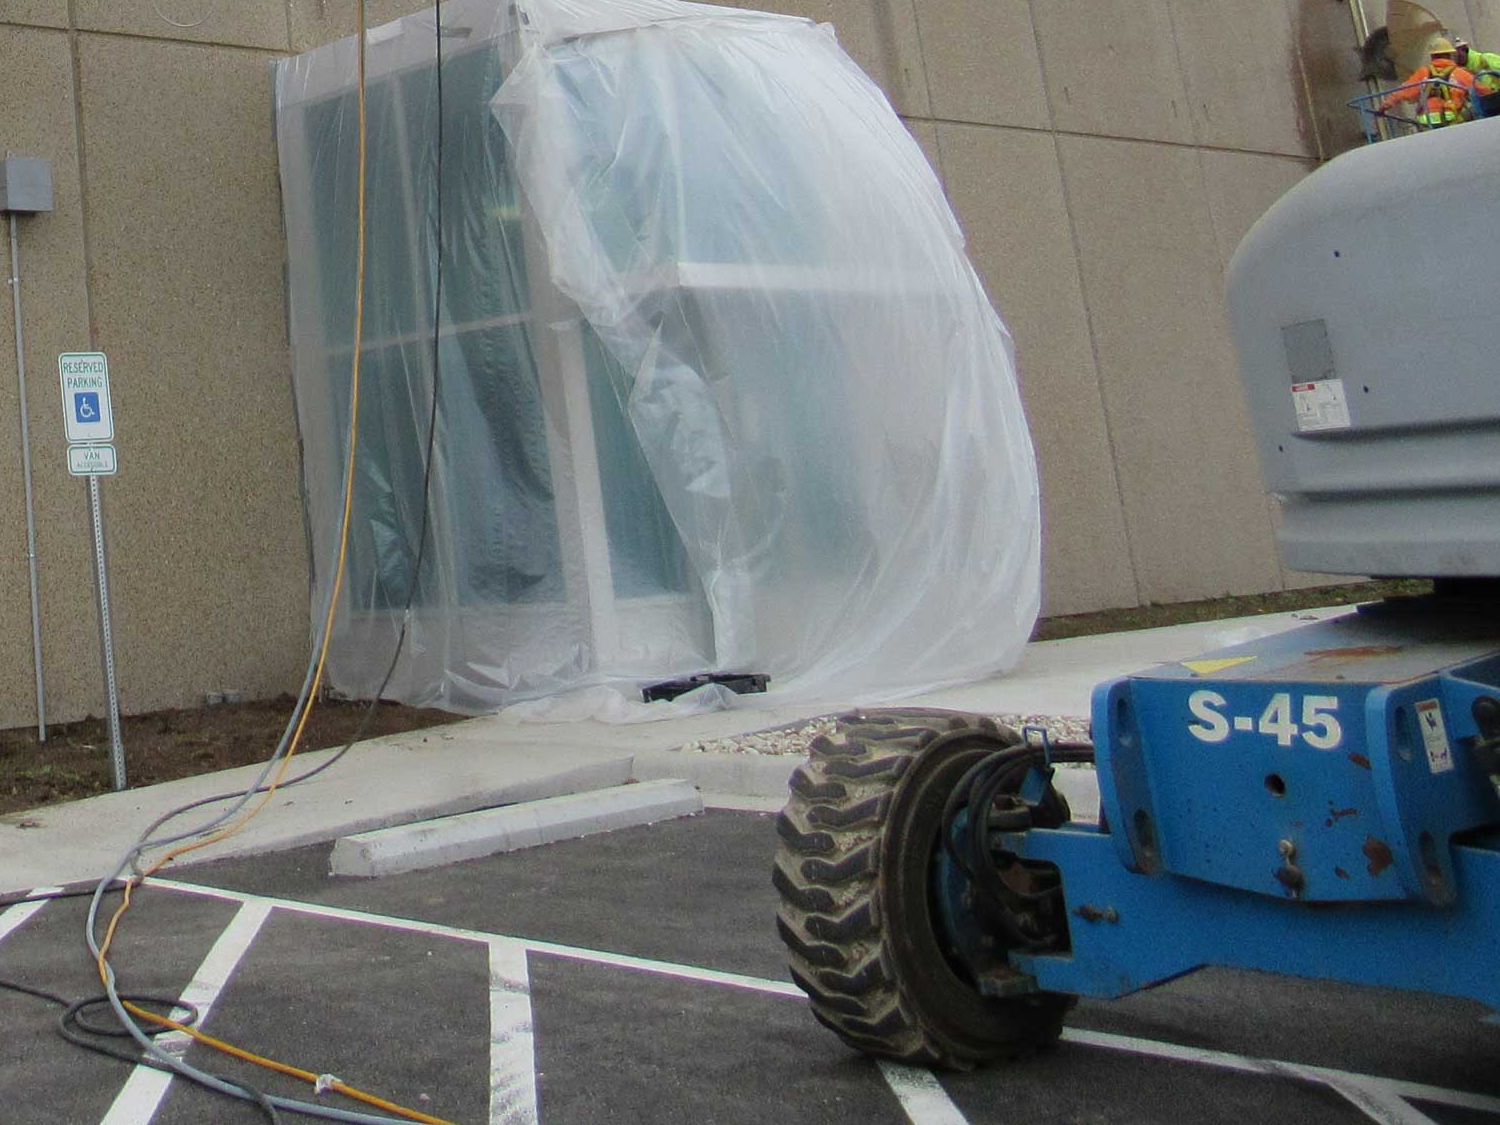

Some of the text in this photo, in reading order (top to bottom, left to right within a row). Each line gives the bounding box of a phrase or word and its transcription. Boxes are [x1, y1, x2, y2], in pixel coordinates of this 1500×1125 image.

[63, 362, 104, 373] RESERVED
[67, 377, 103, 388] PARKING
[84, 451, 100, 460] VAN
[1187, 690, 1342, 749] S-45
